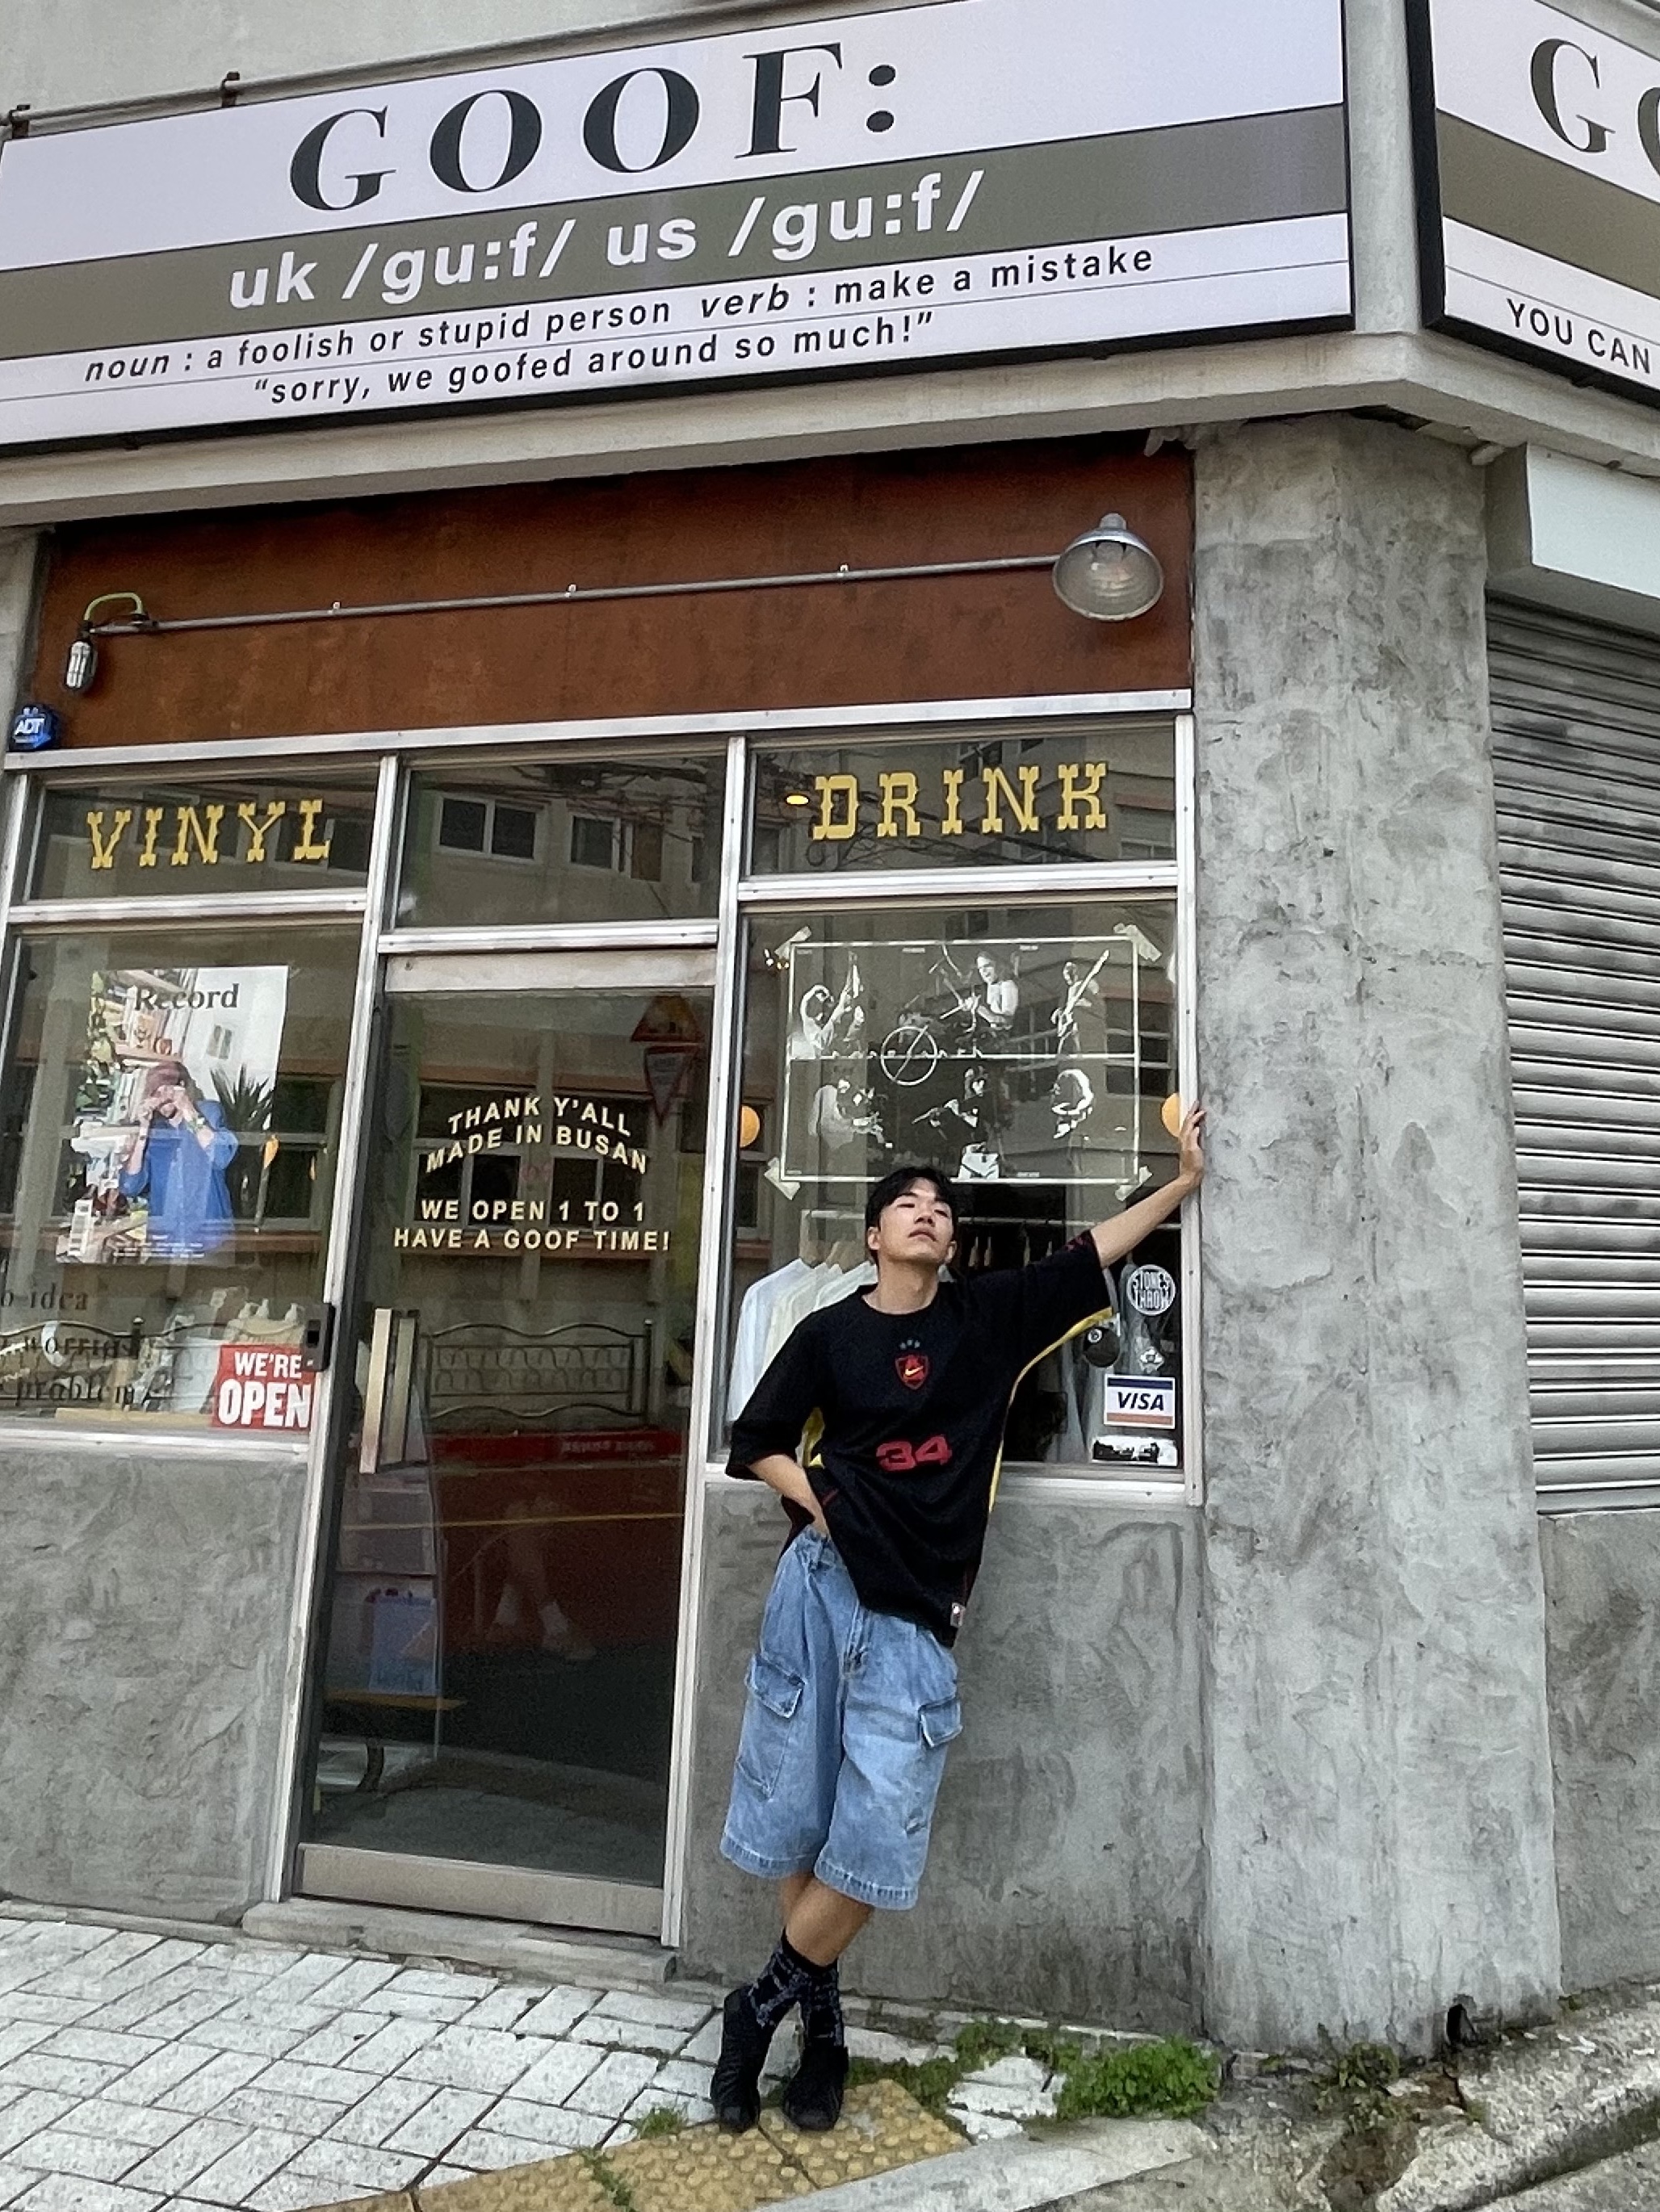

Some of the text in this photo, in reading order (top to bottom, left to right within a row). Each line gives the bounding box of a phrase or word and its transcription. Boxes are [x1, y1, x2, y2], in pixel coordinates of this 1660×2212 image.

[291, 42, 896, 212] GOOF:
[1529, 38, 1660, 178] G
[231, 171, 983, 307] uk /gu:f/ us /gu:f/
[86, 355, 169, 381] noun
[207, 350, 222, 369] a
[239, 329, 354, 366] foolish
[370, 331, 403, 352] or
[418, 310, 530, 349] stupid
[546, 302, 670, 337] person
[702, 283, 789, 318] verb
[835, 270, 934, 304] make
[954, 271, 970, 291] a
[991, 246, 1151, 287] mistake
[1507, 298, 1650, 373] YOU CAN
[388, 371, 432, 392] we
[449, 347, 571, 393] goofed
[589, 334, 717, 372] around
[736, 337, 775, 358] so
[14, 718, 44, 735] ADT
[812, 763, 1106, 840] DRINK
[86, 799, 331, 869] VINYL
[135, 983, 239, 1011] Record
[448, 1096, 631, 1137] THANK Y'ALL
[426, 1124, 647, 1175] MADE IN BUSAN
[421, 1200, 643, 1221] WE OPEN 1 TO 1
[394, 1228, 669, 1251] HAVE A GOOF TIME!
[30, 1282, 89, 1310] idea
[234, 1351, 302, 1378] WE'RE
[218, 1379, 312, 1428] OPEN
[1117, 1391, 1164, 1411] VISA
[876, 1434, 953, 1473] 34
